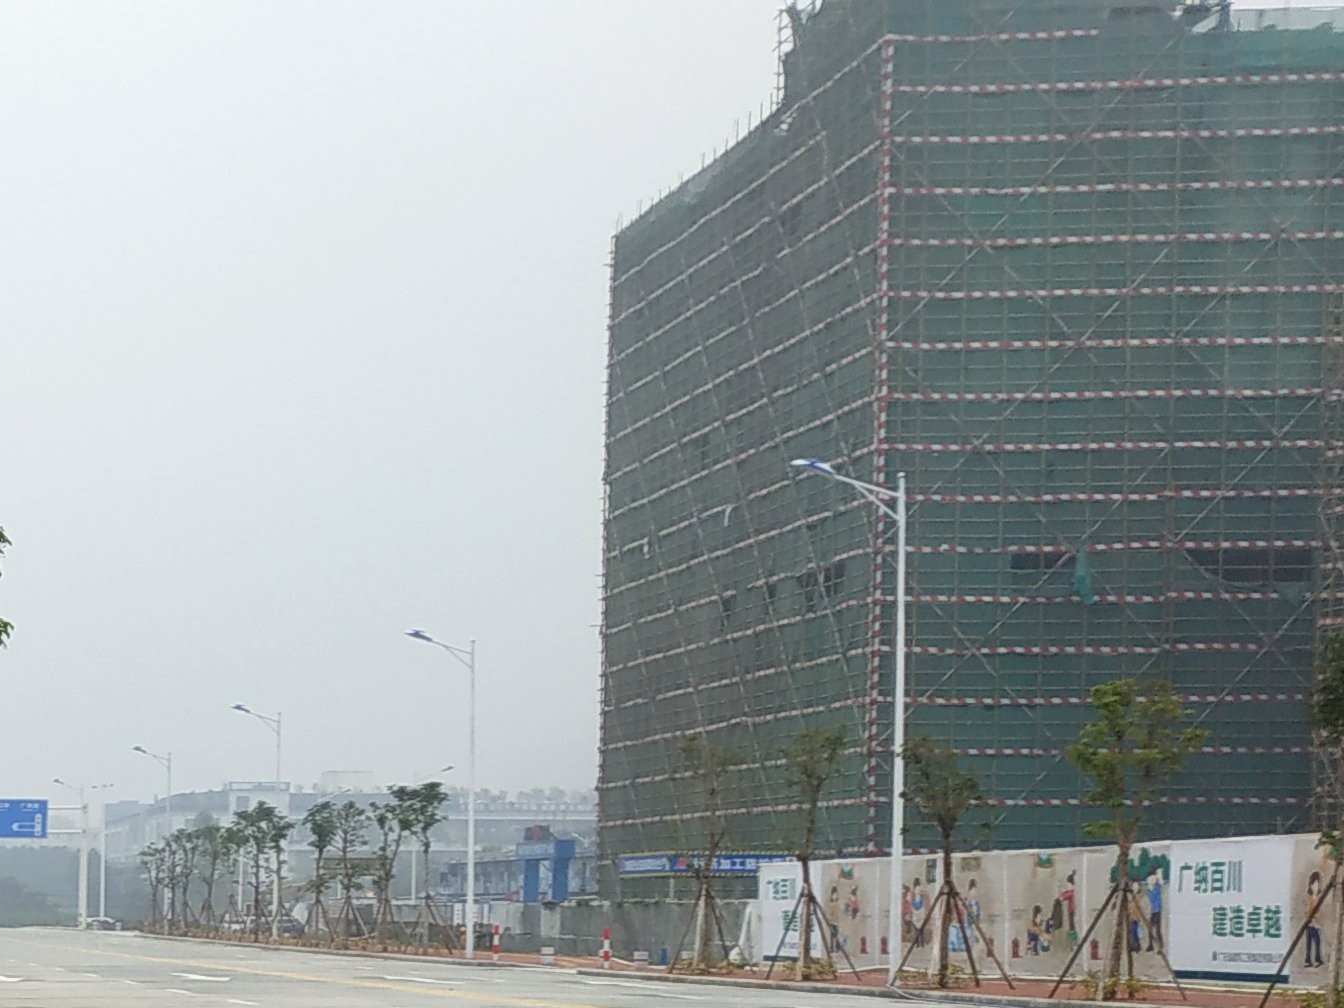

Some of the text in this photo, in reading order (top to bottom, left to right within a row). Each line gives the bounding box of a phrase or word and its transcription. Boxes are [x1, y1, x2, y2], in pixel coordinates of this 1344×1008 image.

[1178, 861, 1243, 893] 广纳百川
[1212, 905, 1282, 938] 建造卓越
